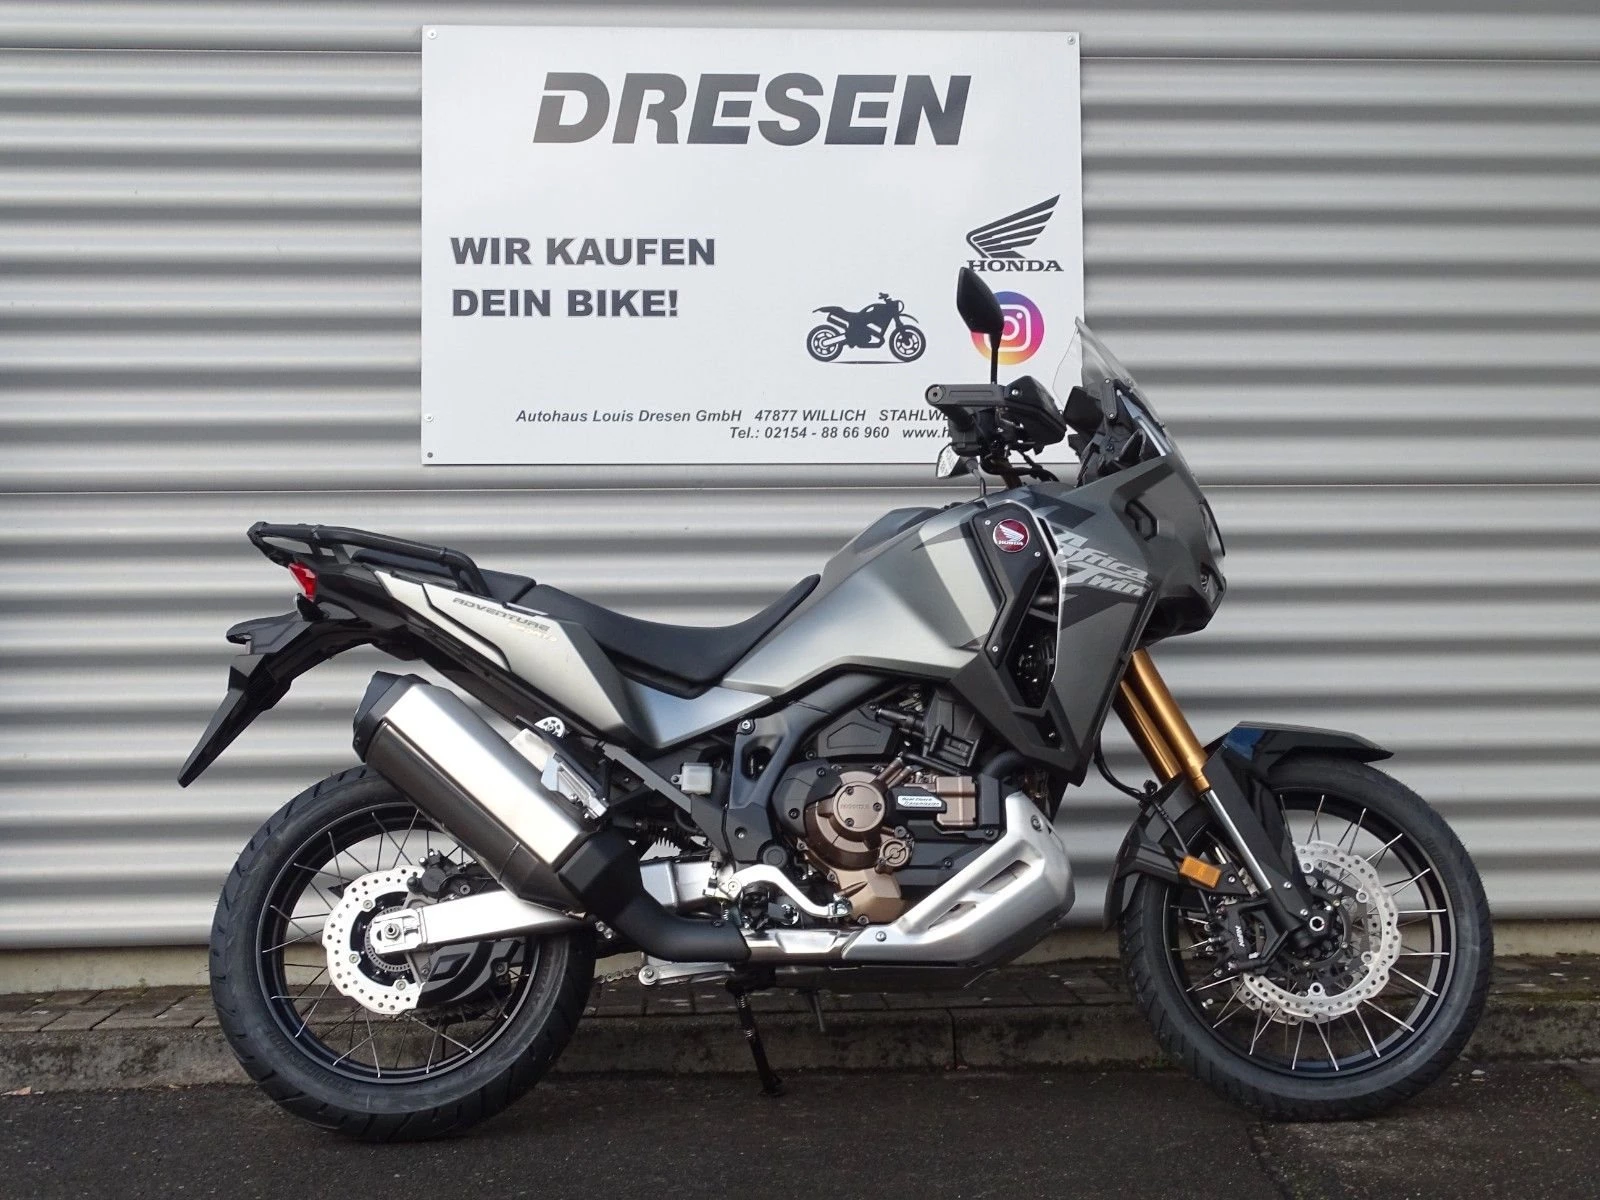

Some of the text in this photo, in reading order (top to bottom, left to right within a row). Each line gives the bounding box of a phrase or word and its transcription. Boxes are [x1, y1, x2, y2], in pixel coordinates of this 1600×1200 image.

[534, 72, 972, 147] DRESEN
[450, 237, 716, 266] WIR KAUFEN
[966, 259, 1064, 273] HONDA
[452, 289, 679, 317] DEIN BIKE!
[516, 409, 588, 422] Autohaus
[593, 409, 634, 422] Louis
[639, 409, 691, 422] Dresen
[696, 409, 743, 422] GmbH
[755, 409, 798, 422] 47877
[803, 409, 867, 422] WILLICH
[730, 426, 760, 439] Tel.:
[765, 426, 807, 439] 02154
[822, 426, 839, 439] 88
[843, 426, 860, 439] 66
[864, 426, 890, 439] 960
[452, 597, 551, 632] ADVENTURE
